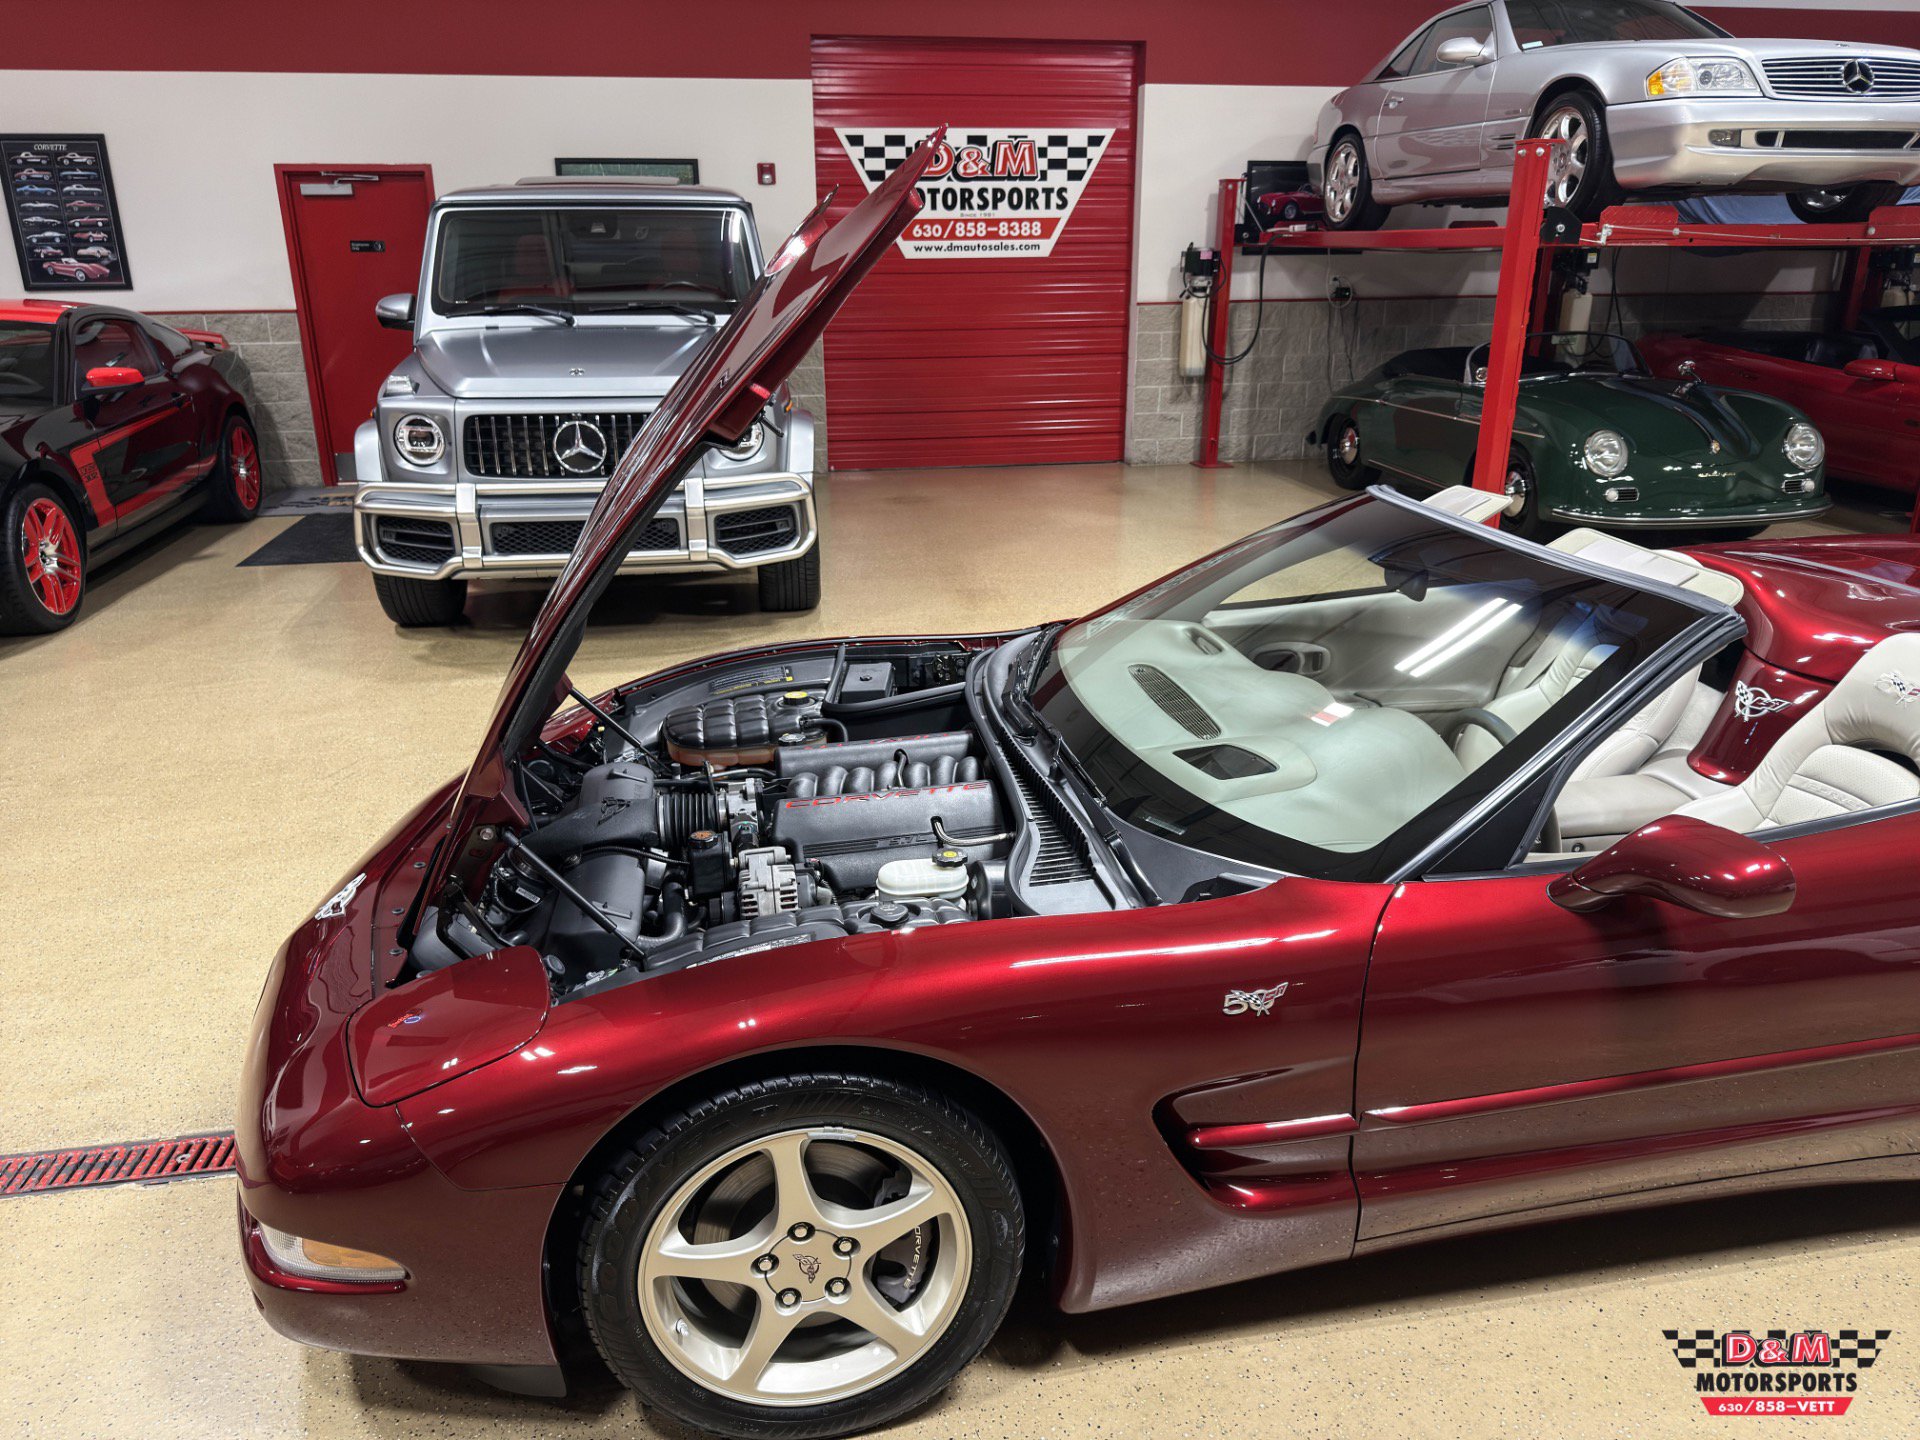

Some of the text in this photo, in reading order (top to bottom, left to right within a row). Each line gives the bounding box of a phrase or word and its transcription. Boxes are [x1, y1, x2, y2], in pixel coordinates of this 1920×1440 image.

[33, 143, 67, 151] CORVETTE
[918, 138, 1039, 181] D&M
[915, 186, 1068, 211] TORSPORTS
[912, 220, 1042, 239] 630/858-8388
[914, 241, 1041, 253] www.dmautosales.com
[903, 1225, 922, 1288] ORVETTE
